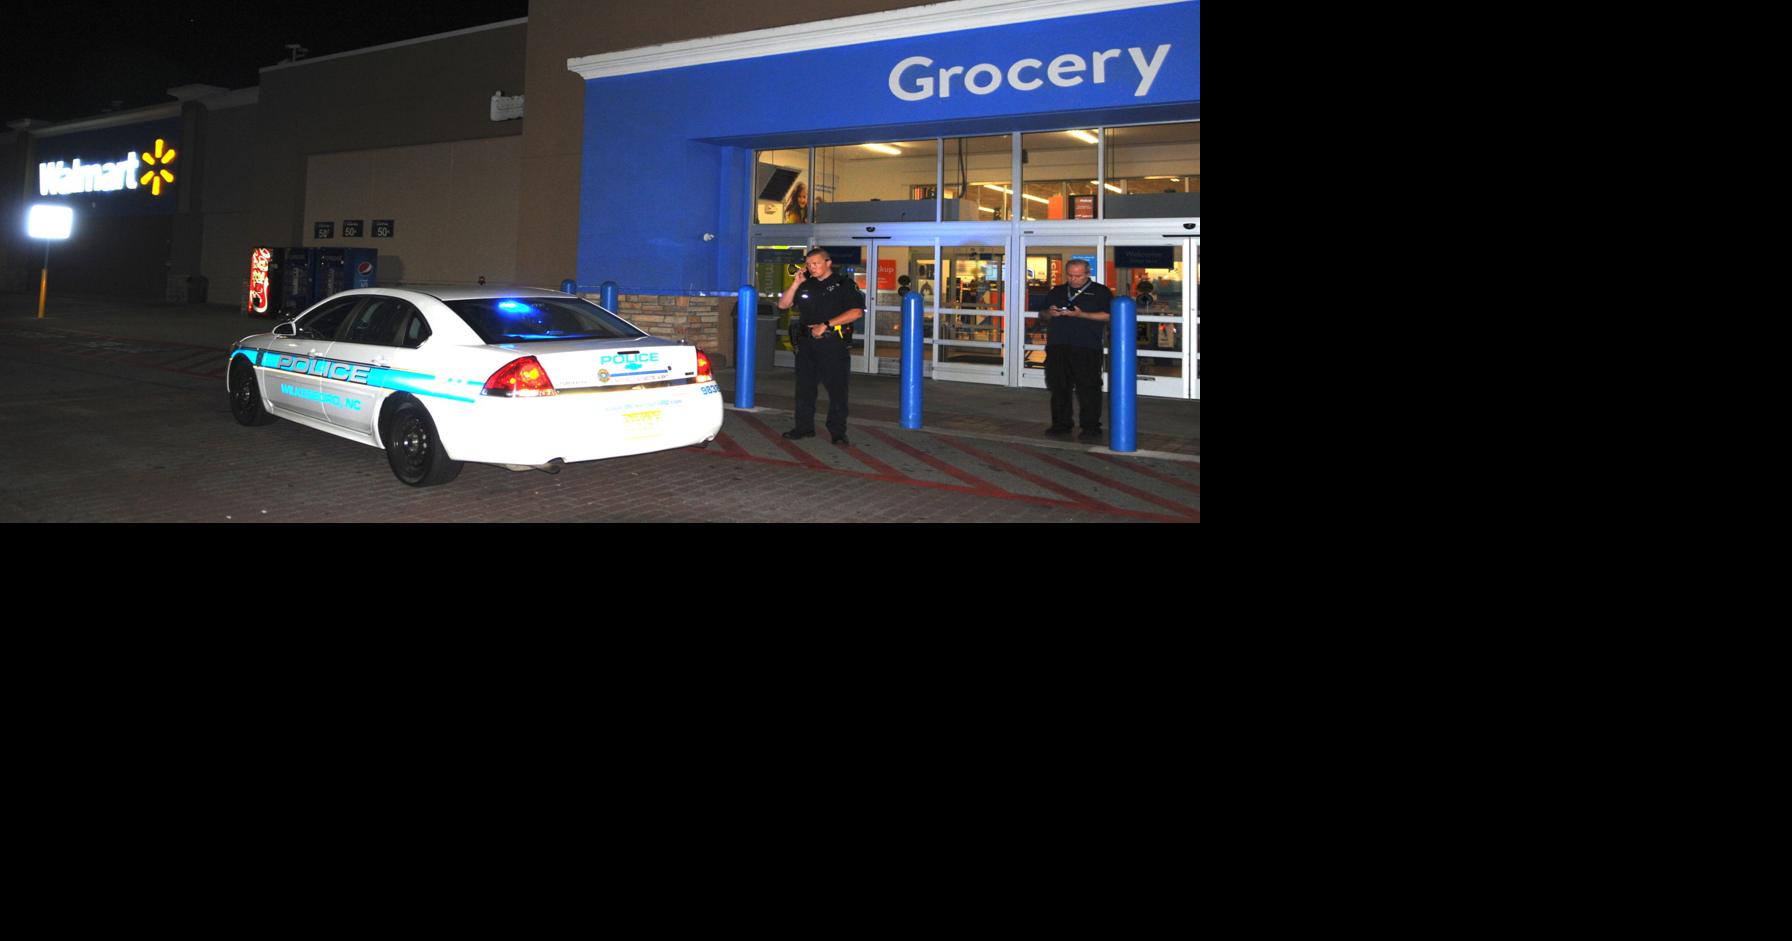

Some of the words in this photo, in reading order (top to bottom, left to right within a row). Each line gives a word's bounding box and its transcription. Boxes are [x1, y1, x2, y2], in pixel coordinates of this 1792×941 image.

[888, 44, 1171, 101] Grocery
[39, 151, 140, 196] Walmart
[278, 354, 370, 384] POLICE
[600, 352, 660, 365] POLICE
[345, 398, 362, 411] NC
